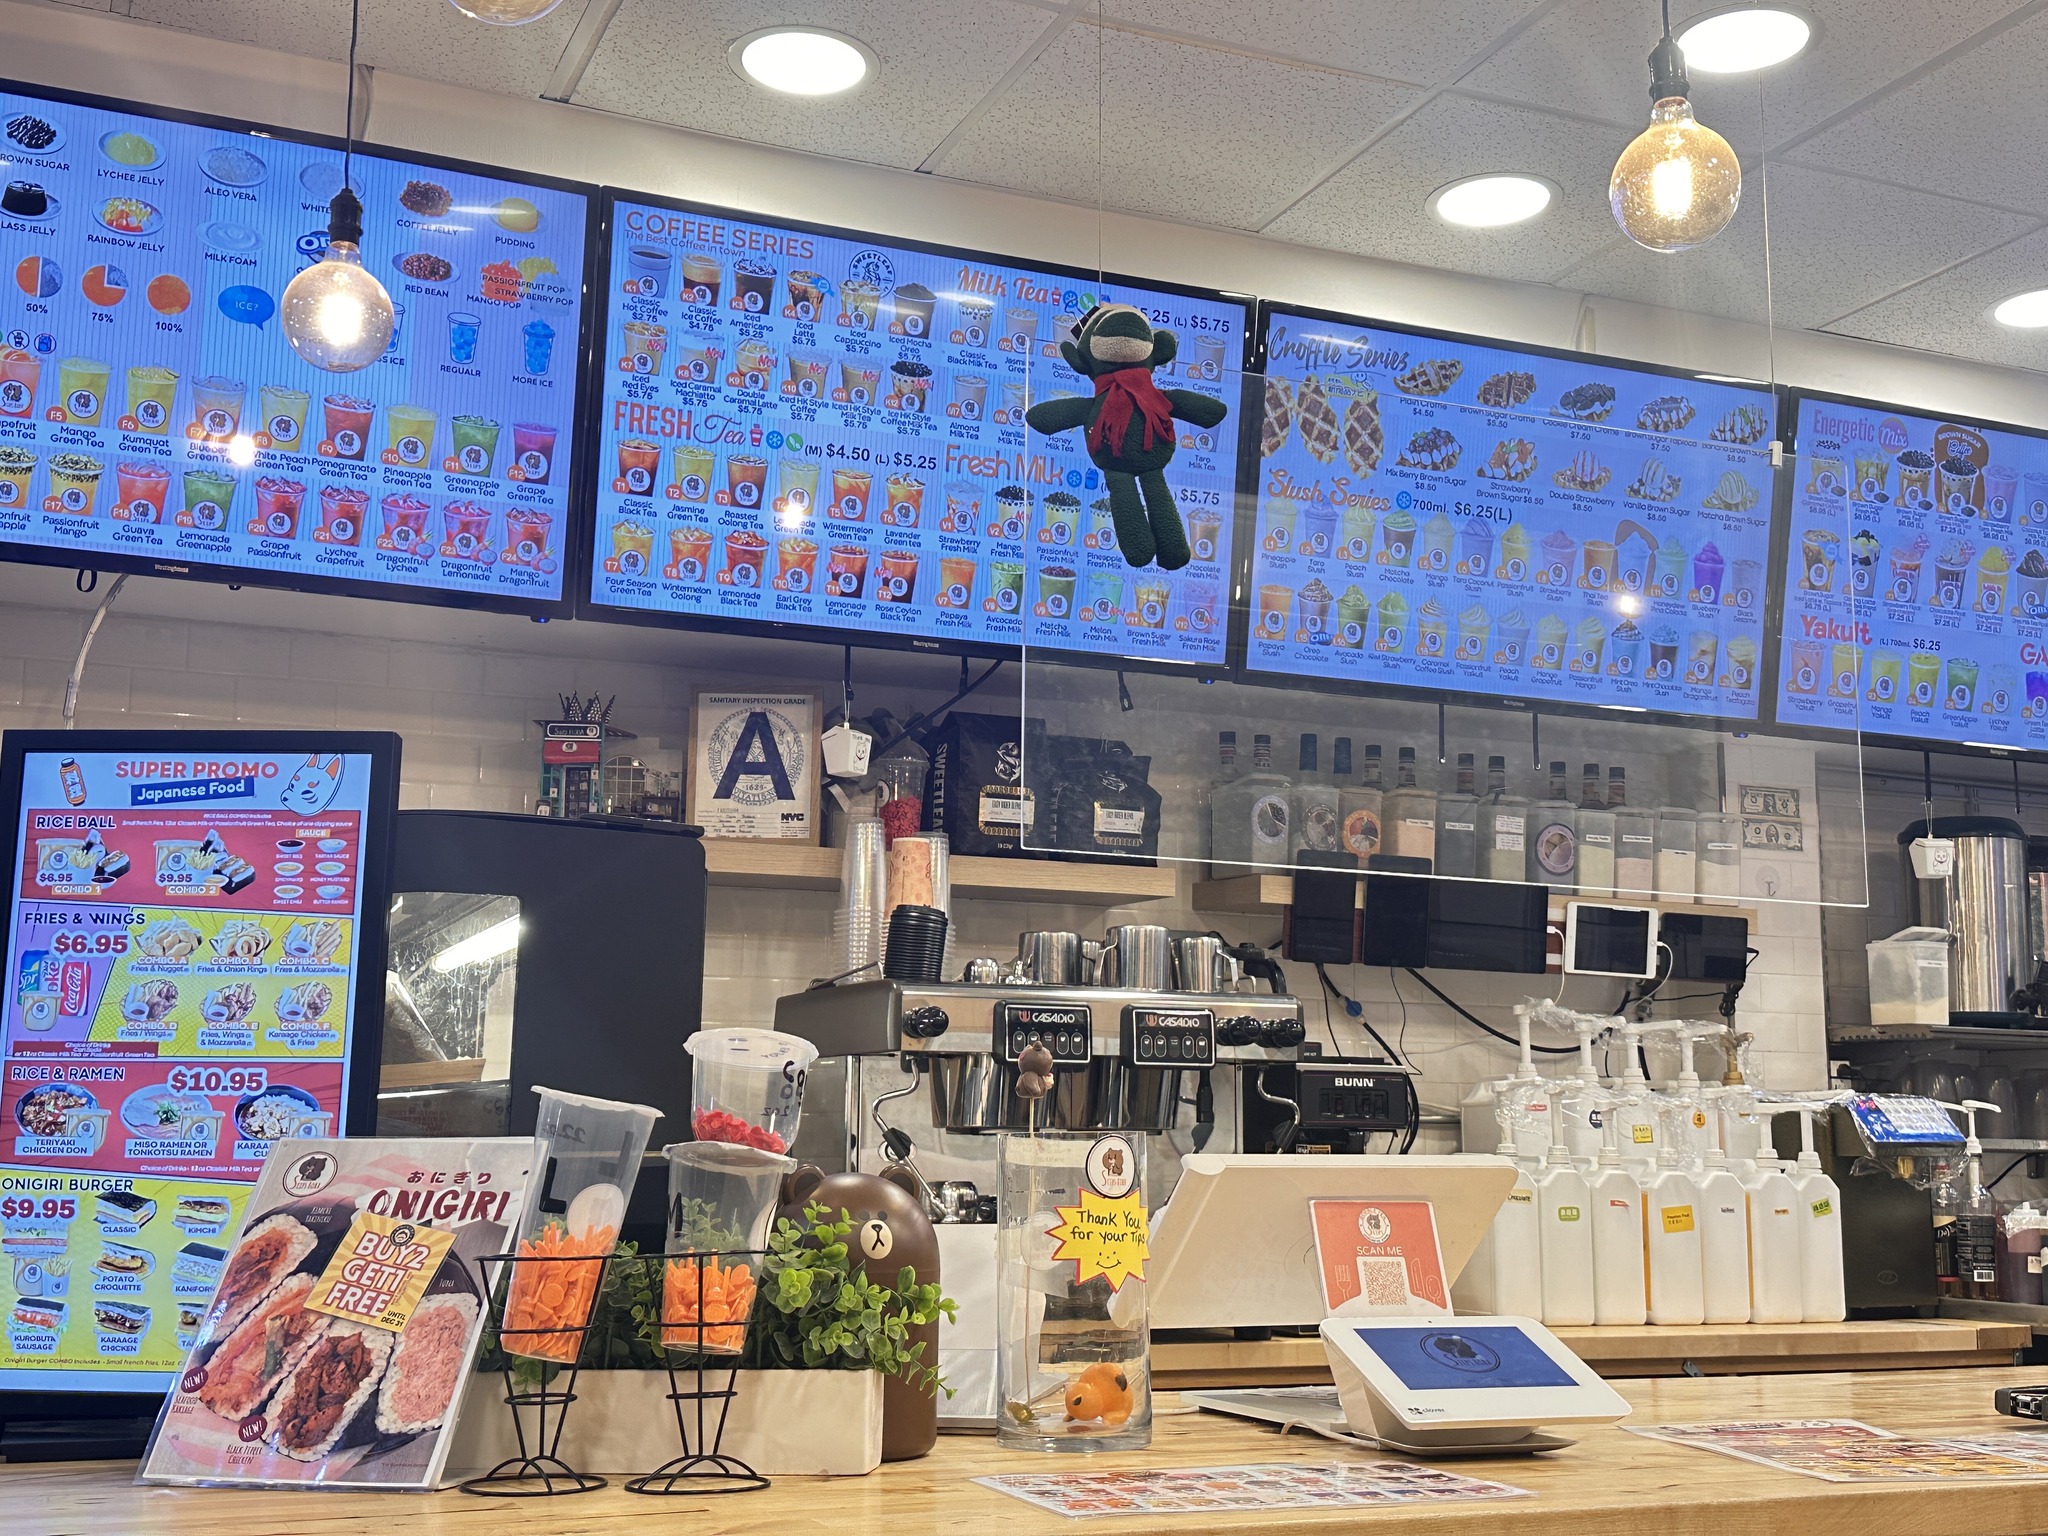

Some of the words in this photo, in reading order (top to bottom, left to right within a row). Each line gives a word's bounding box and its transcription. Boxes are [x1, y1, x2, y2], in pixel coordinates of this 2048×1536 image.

[97, 169, 136, 182] LYCHEE
[138, 174, 165, 187] JELLY
[232, 190, 257, 201] VERA
[627, 211, 725, 245] COFFEE
[731, 229, 814, 259] SERIES
[87, 234, 136, 247] RAINBOW
[138, 242, 165, 253] JELLY
[495, 236, 535, 249] PUDDING
[625, 229, 644, 242] The
[646, 232, 668, 245] Best
[671, 236, 706, 251] Coffee
[708, 242, 717, 252] in
[718, 244, 745, 257] town
[205, 252, 228, 263] MILK
[229, 256, 257, 267] FOAM
[404, 284, 423, 295] RED
[425, 287, 449, 298] BEAN
[626, 283, 637, 292] K1
[466, 294, 501, 308] MANGO
[503, 300, 521, 310] POP
[957, 265, 1007, 298] Milk
[1013, 277, 1048, 304] Tea
[1174, 316, 1187, 328] (L)
[1190, 315, 1230, 333] $5.75
[26, 303, 48, 314] 50%
[91, 312, 114, 323] 75%
[235, 301, 258, 312] ICE?
[622, 303, 637, 312] Hot
[639, 306, 668, 317] Coffee
[632, 313, 658, 323] $2.75
[155, 322, 183, 333] 100%
[1269, 326, 1343, 371] Croffle
[1347, 336, 1409, 371] Series
[512, 376, 538, 386] MORE
[539, 379, 553, 388] ICE
[60, 426, 96, 438] Mango
[1813, 409, 1875, 443] Energetic
[1880, 429, 1908, 447] Mix
[50, 434, 84, 445] Green
[614, 401, 692, 440] FRESH
[693, 415, 746, 445] Tea
[805, 446, 823, 457] (M)
[826, 443, 870, 462] $4.50
[875, 454, 890, 465] (L)
[894, 452, 937, 470] $5.25
[945, 445, 1011, 480] Fresh
[1016, 454, 1063, 485] Milk
[1386, 468, 1400, 477] Mix
[1400, 471, 1419, 481] Berry
[1419, 474, 1443, 484] Brown
[1444, 476, 1466, 487] Sugar
[1180, 489, 1220, 505] $5.75
[1268, 468, 1323, 503] Slush
[1329, 476, 1391, 512] Series
[1413, 499, 1449, 514] 700ml.
[1454, 502, 1512, 524] $6.25(L)
[44, 500, 62, 511] F17
[672, 504, 705, 515] Jasmine
[113, 509, 130, 518] F18
[667, 512, 690, 522] Green
[692, 515, 708, 523] Tea
[43, 516, 99, 529] Passionfruit
[54, 526, 87, 538] Mango
[180, 531, 230, 543] Lemonade
[176, 539, 232, 552] Greenapple
[324, 547, 357, 558] Lychee
[1800, 614, 1873, 645] Yakult
[1913, 638, 1941, 651] $6.25
[713, 712, 795, 800] A
[115, 761, 187, 778] SUPER
[193, 762, 279, 778] PROMO
[137, 785, 205, 802] Japanese
[209, 779, 245, 794] Food
[36, 816, 73, 828] RICE
[77, 817, 116, 828] BALL
[781, 813, 804, 821] NYC
[39, 873, 72, 882] $6.95
[159, 873, 192, 883] $9.95
[209, 886, 216, 894] 2
[25, 913, 67, 924] FRIES
[73, 913, 83, 924] &
[89, 913, 145, 925] WINGS
[54, 933, 128, 955] $6.95
[1032, 1013, 1075, 1023] CASADIO
[1159, 1016, 1199, 1027] CASADIO
[13, 1068, 49, 1079] RICE
[54, 1068, 64, 1079] &
[69, 1068, 124, 1079] RAMEN
[171, 1070, 263, 1092] $10.95
[1335, 1078, 1374, 1087] BUNN
[2, 1178, 63, 1190] ONIGIRI
[69, 1179, 133, 1191] BURGER
[407, 1171, 492, 1185] おにぎり
[1, 1197, 75, 1220] $9.95
[367, 1189, 511, 1222] ONIGIRI
[1076, 1210, 1117, 1226] Thank
[1123, 1211, 1140, 1229] You
[1070, 1226, 1093, 1240] for
[1099, 1232, 1127, 1244] your
[1357, 1246, 1384, 1255] SCAN
[1387, 1247, 1402, 1255] ME
[324, 1280, 393, 1319] FREE
[381, 1316, 395, 1325] DEC
[387, 1310, 406, 1321] UNTIL
[101, 1344, 137, 1352] CHICKEN
[184, 1371, 204, 1390] NEW!
[242, 1421, 262, 1439] NEW!
